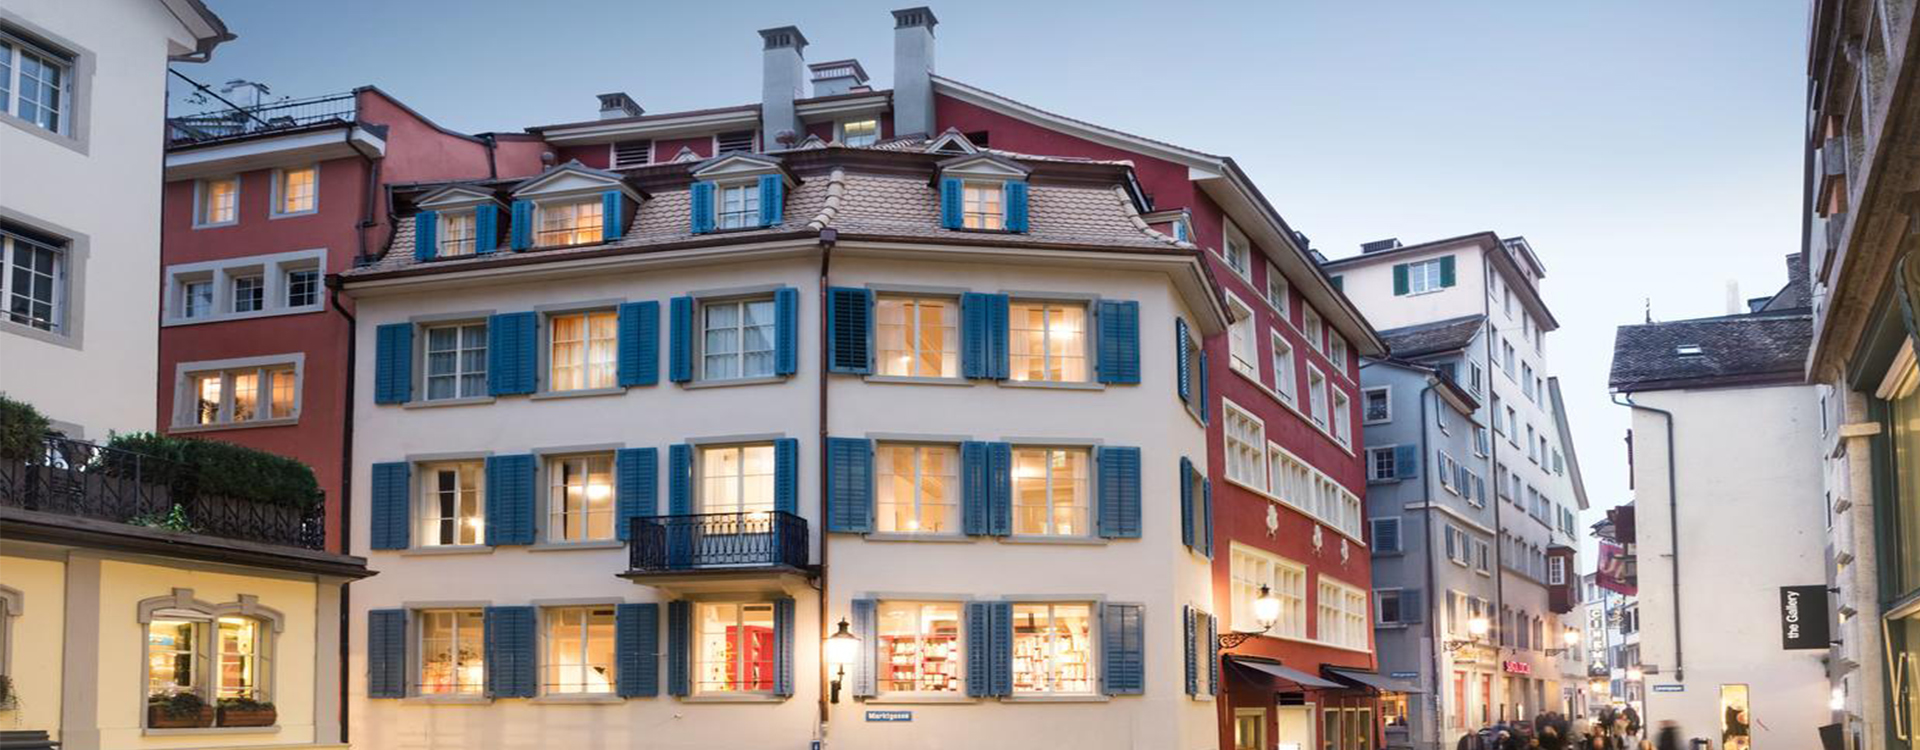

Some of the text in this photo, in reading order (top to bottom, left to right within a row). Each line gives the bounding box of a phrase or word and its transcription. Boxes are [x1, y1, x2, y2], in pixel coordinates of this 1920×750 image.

[1591, 609, 1604, 669] CINEMA
[1785, 590, 1800, 639] the Gallery
[868, 712, 909, 721] Marktgasse
